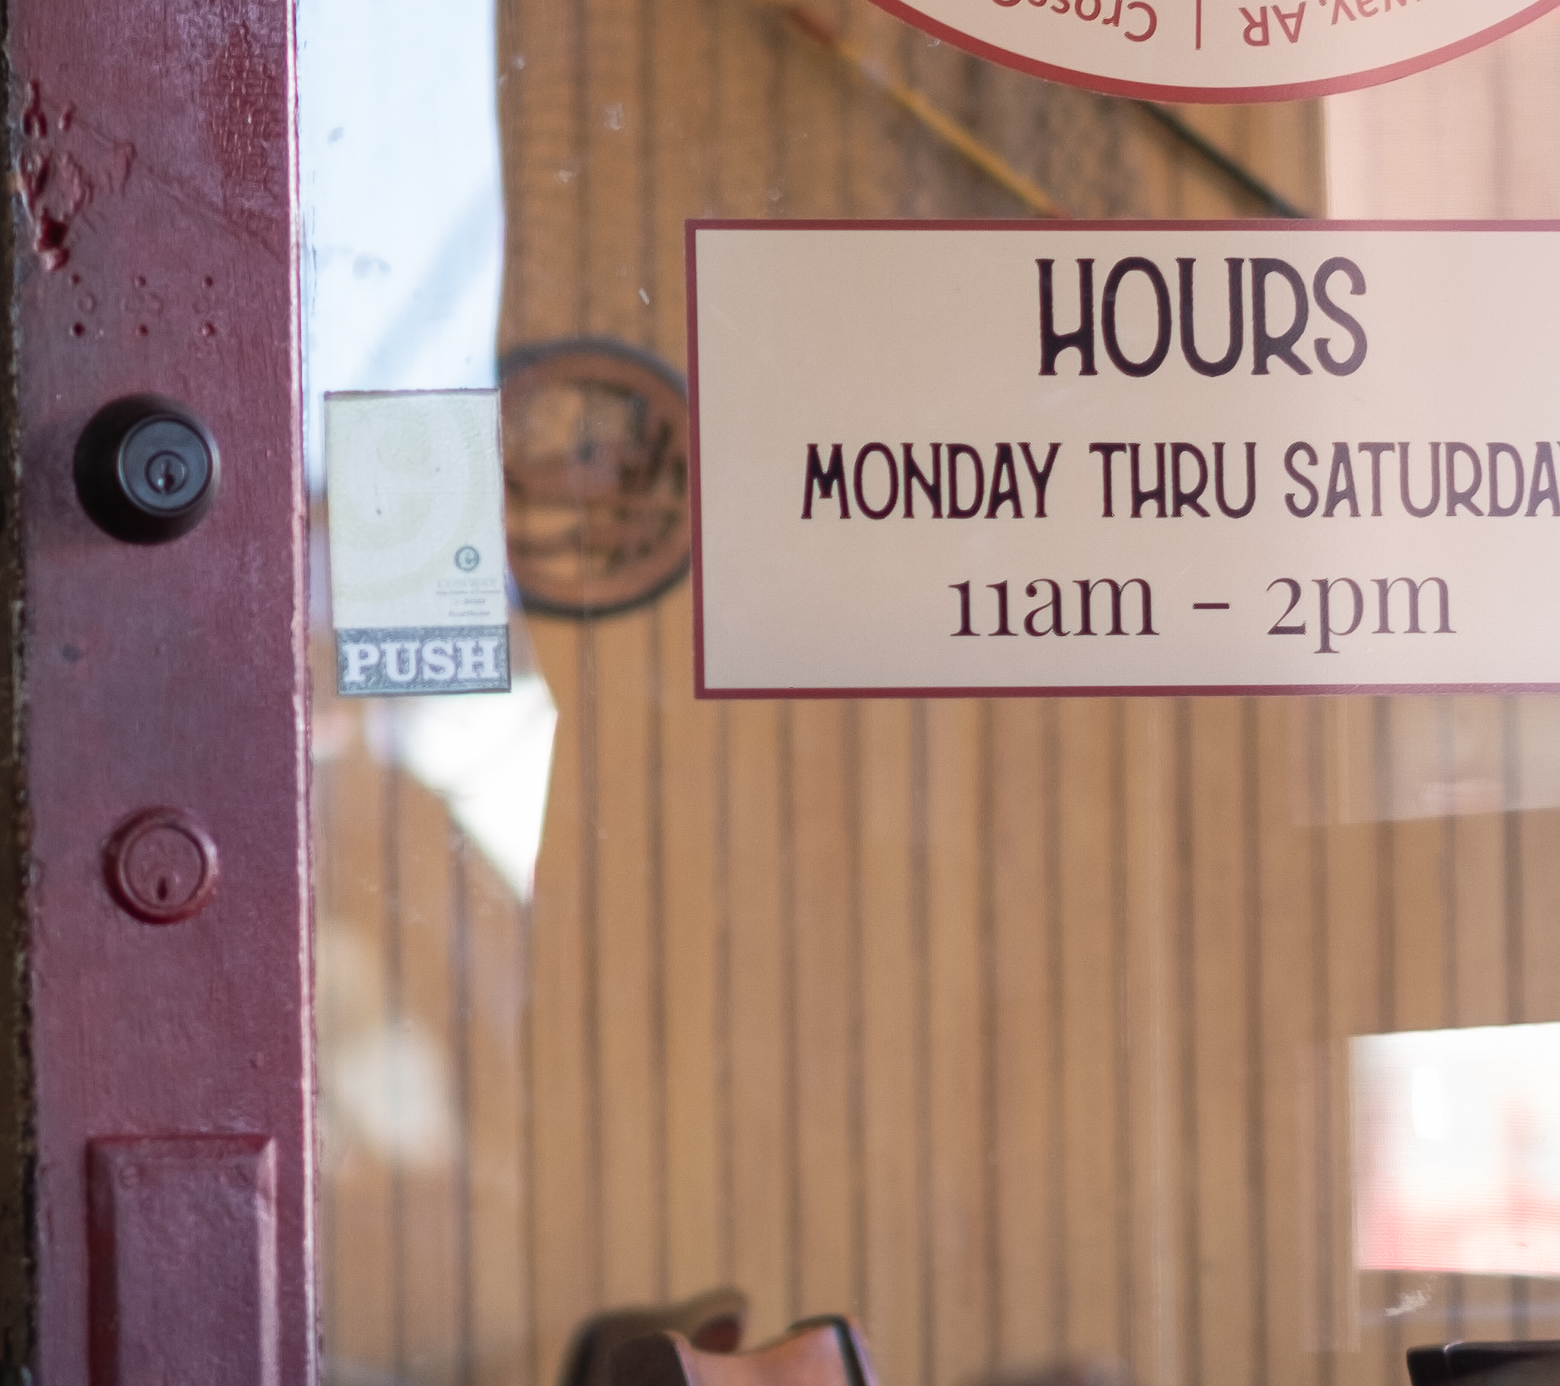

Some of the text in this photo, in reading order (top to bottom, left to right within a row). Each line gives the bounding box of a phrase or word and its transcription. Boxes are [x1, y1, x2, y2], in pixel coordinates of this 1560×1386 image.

[1239, 0, 1307, 47] AR
[1036, 256, 1369, 379] HOURS
[800, 442, 1062, 522] MONDAY
[1089, 442, 1257, 520] THRU
[948, 575, 1160, 639] 11am
[1265, 574, 1457, 654] 2pm
[343, 638, 499, 682] PUSH
